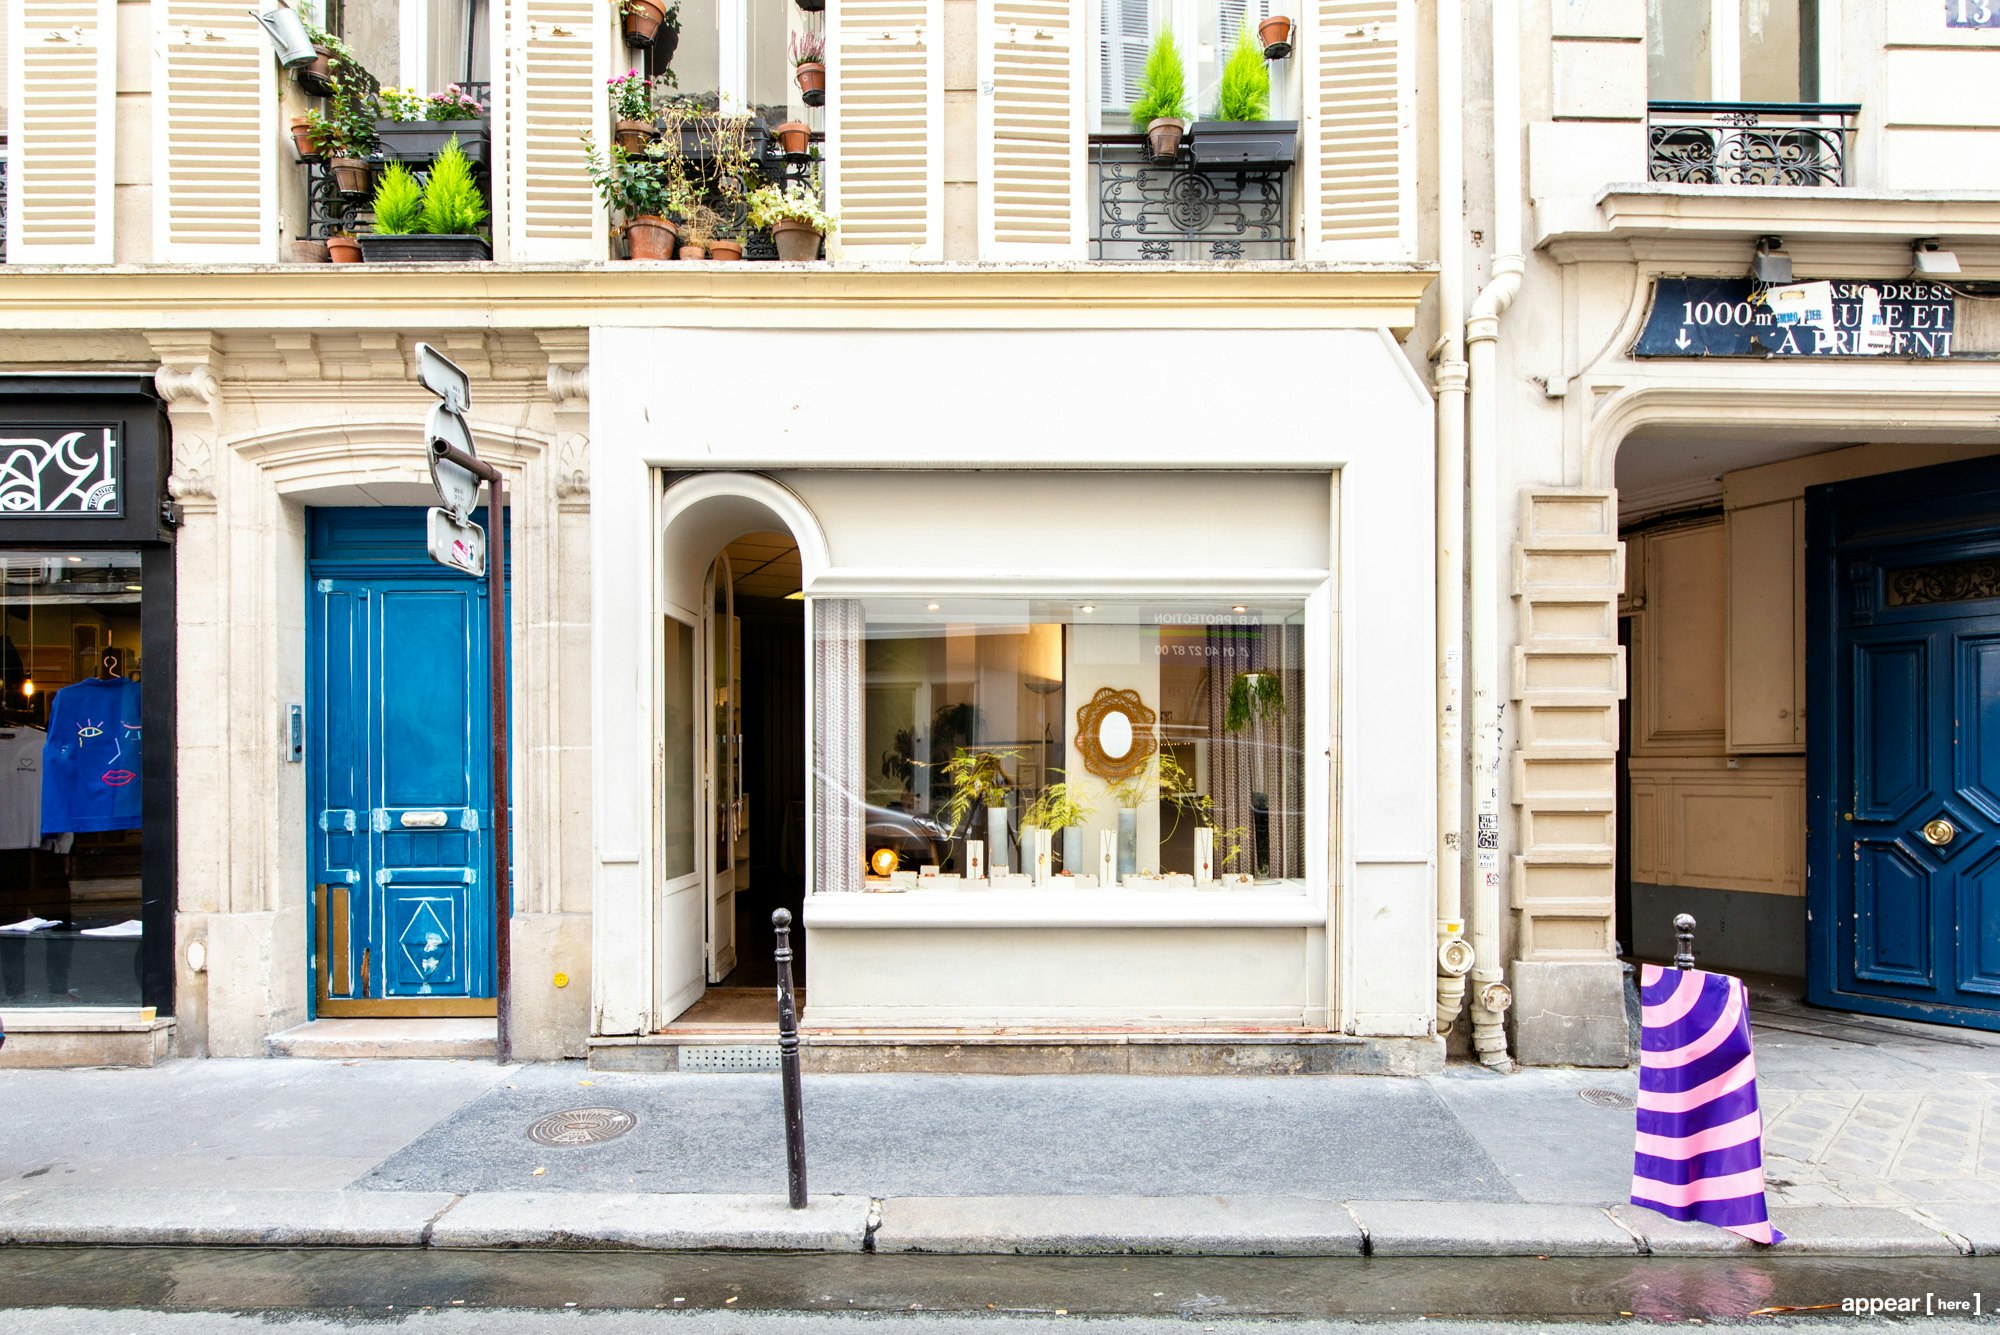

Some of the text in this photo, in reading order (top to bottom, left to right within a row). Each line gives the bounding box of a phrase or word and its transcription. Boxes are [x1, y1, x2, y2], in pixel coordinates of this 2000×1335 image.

[1957, 0, 1991, 23] 13
[1882, 284, 1953, 300] DRESS
[1910, 304, 1951, 329] ET
